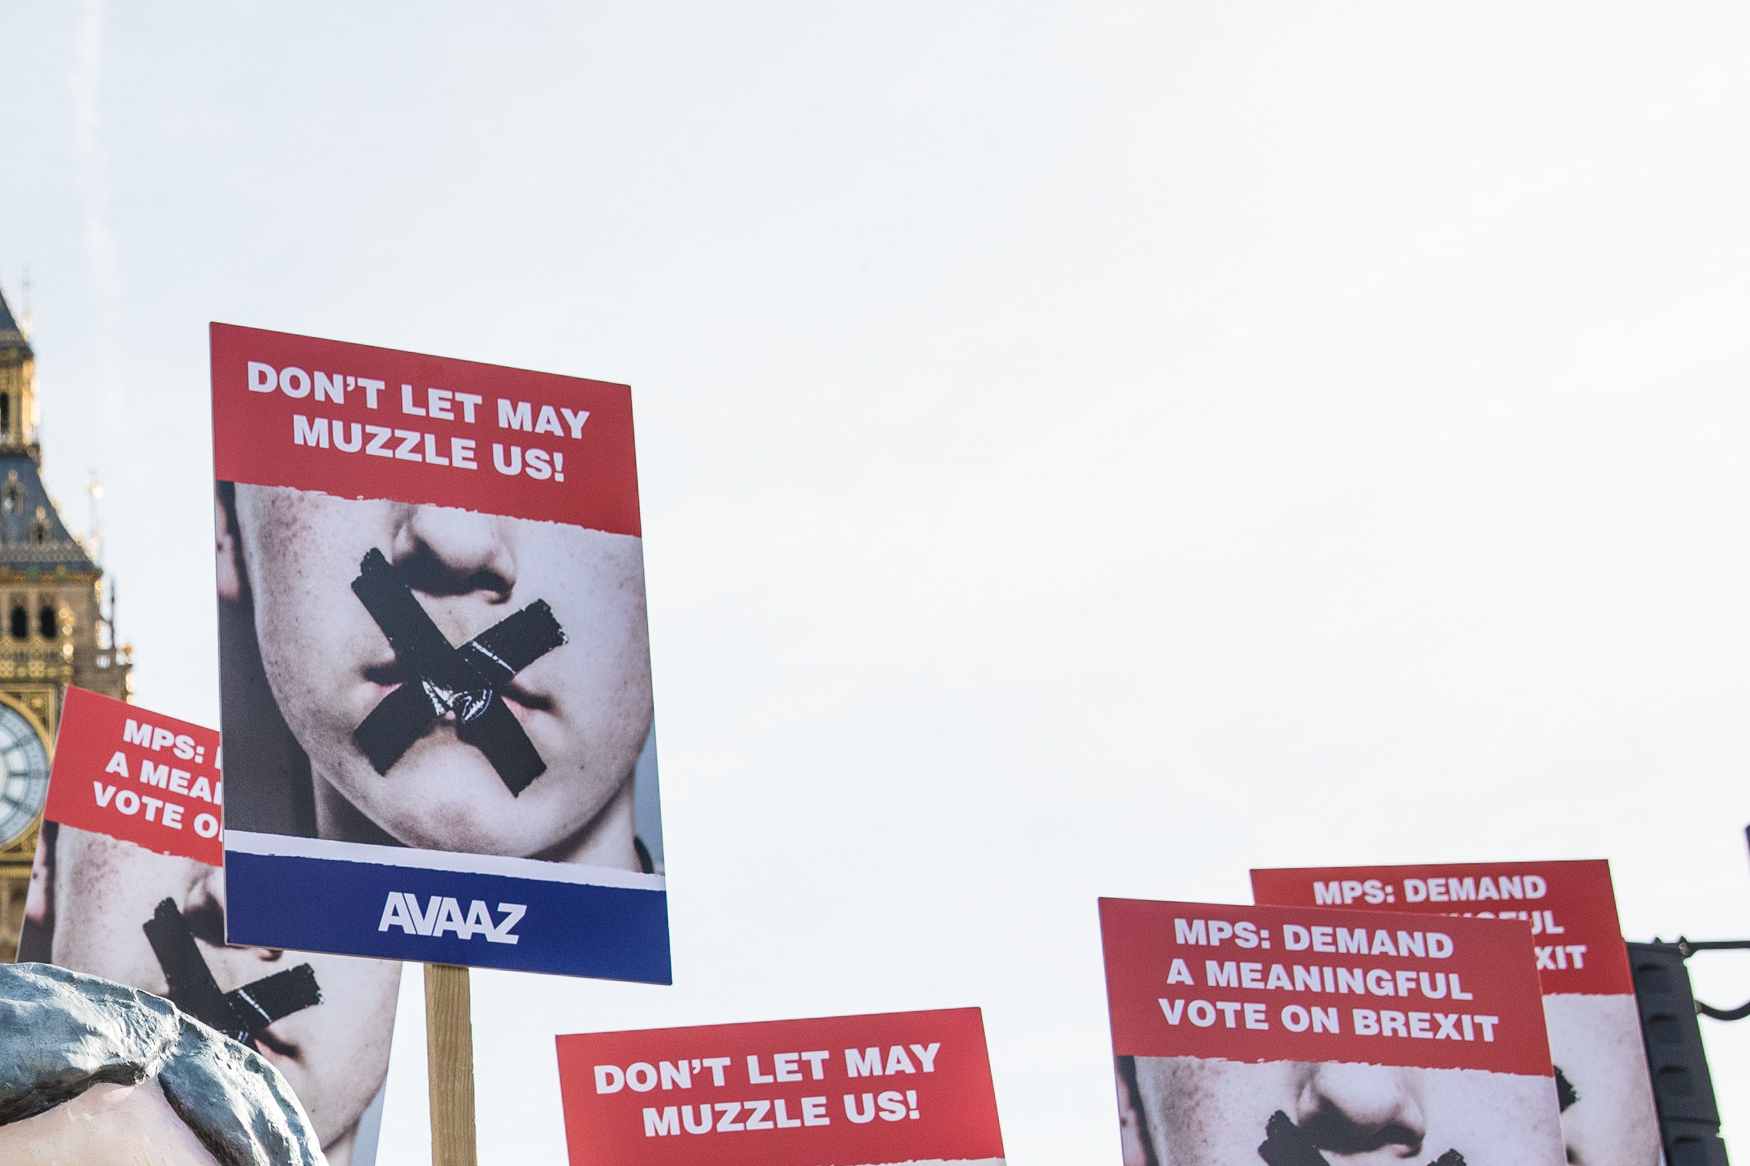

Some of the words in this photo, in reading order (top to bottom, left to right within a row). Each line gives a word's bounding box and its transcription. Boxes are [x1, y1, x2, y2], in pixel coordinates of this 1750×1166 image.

[247, 361, 385, 410] DON’T
[401, 384, 483, 424] LET
[497, 398, 590, 440] MAY
[293, 414, 479, 470] MUZZLE
[492, 443, 565, 483] US!
[123, 718, 205, 764] MPS:
[105, 751, 129, 778] A
[140, 760, 222, 805] MEA
[93, 781, 185, 830] VOTE
[194, 813, 223, 843] O
[1313, 881, 1395, 906] MPS:
[1403, 875, 1547, 902] DEMAND
[378, 891, 528, 945] AVAAZ
[1174, 918, 1271, 950] MPS:
[1283, 924, 1454, 959] DEMAND
[1166, 958, 1194, 986] A
[1205, 960, 1473, 1000] MEANINGFUL
[1158, 998, 1270, 1030] VOTE
[1281, 1004, 1341, 1034] ON
[1353, 1007, 1499, 1042] BREXIT
[593, 1057, 731, 1095] DON’T
[747, 1050, 830, 1085] LET
[845, 1042, 941, 1078] MAY
[643, 1096, 830, 1137] MUZZLE
[844, 1090, 920, 1125] US!
